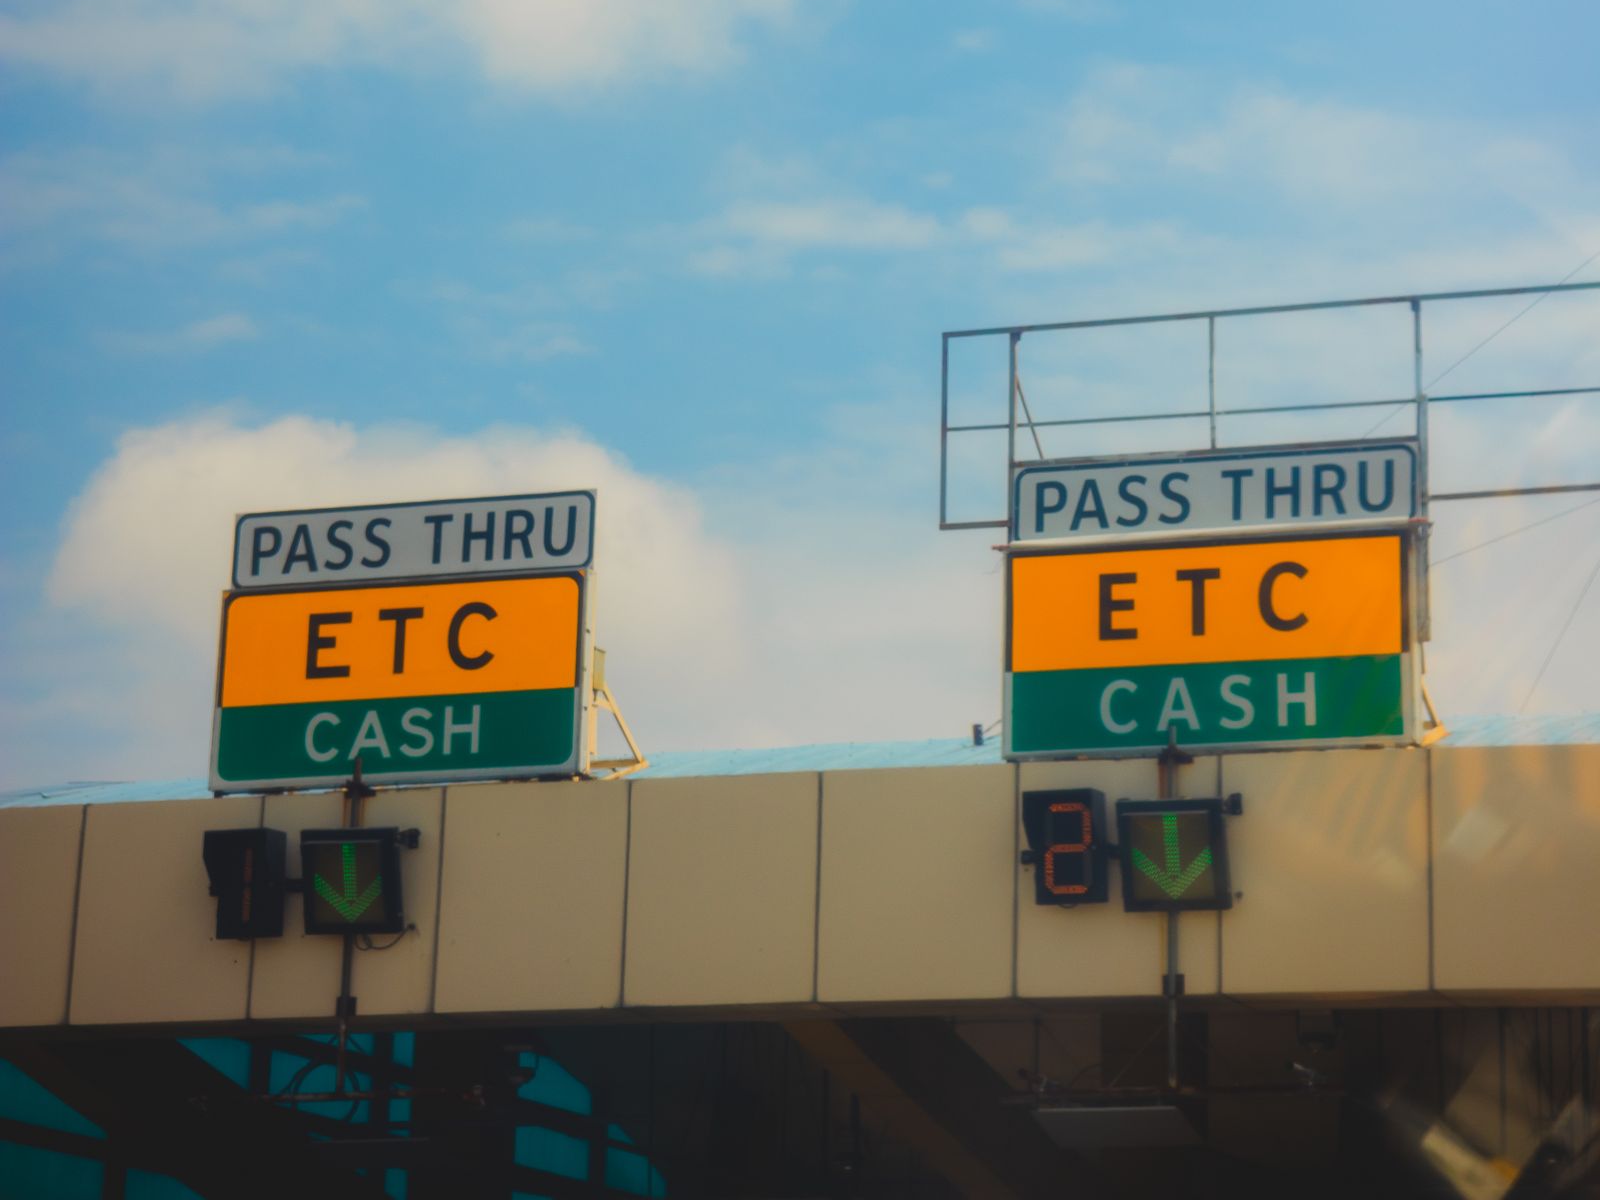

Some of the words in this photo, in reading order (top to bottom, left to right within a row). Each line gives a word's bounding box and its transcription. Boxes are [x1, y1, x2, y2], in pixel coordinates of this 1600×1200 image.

[1035, 472, 1190, 533] PASS
[1221, 459, 1395, 521] THRU
[251, 518, 391, 576] PASS
[424, 505, 577, 563] THRU
[1099, 561, 1309, 641] ETC
[305, 602, 498, 680] ETC
[305, 704, 481, 762] CASH
[1100, 672, 1316, 734] CASH
[1044, 802, 1092, 894] 2
